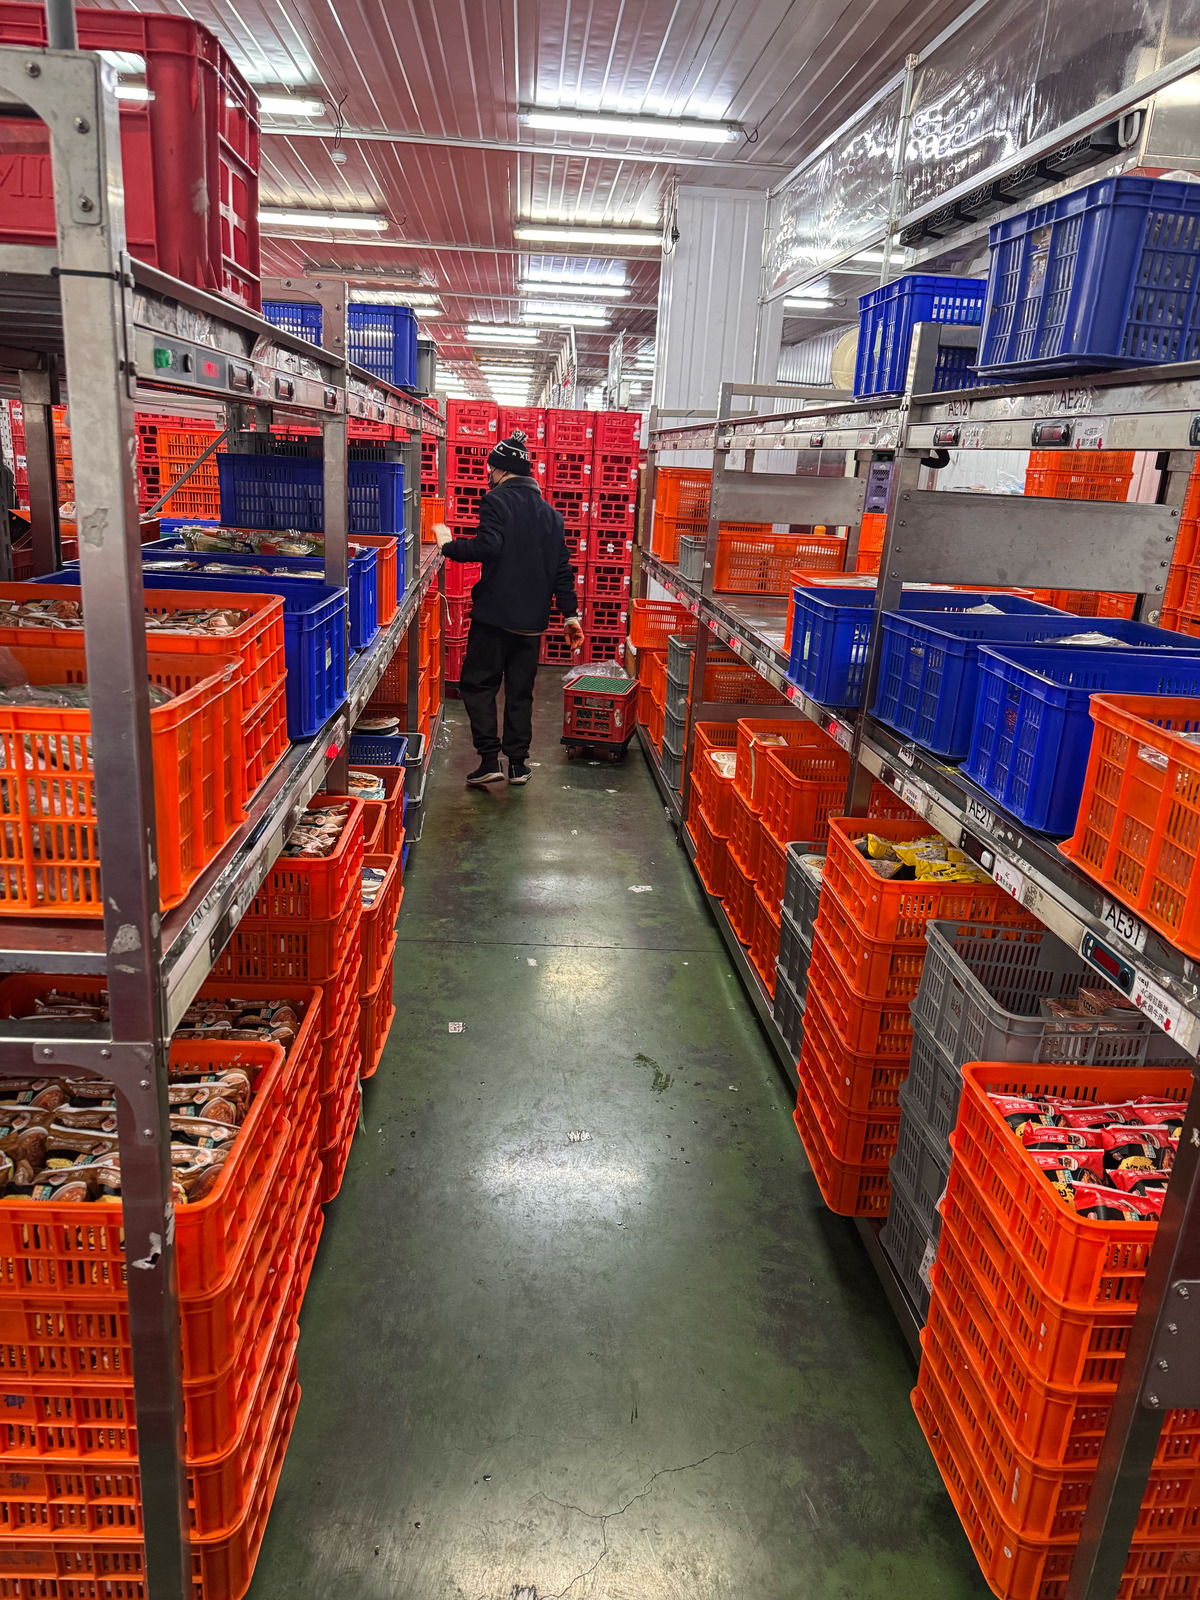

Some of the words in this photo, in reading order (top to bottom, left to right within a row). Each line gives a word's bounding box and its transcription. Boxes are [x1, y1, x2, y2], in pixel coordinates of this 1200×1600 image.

[947, 399, 968, 417] AE12
[968, 799, 991, 828] AE21
[1104, 904, 1142, 946] AE31
